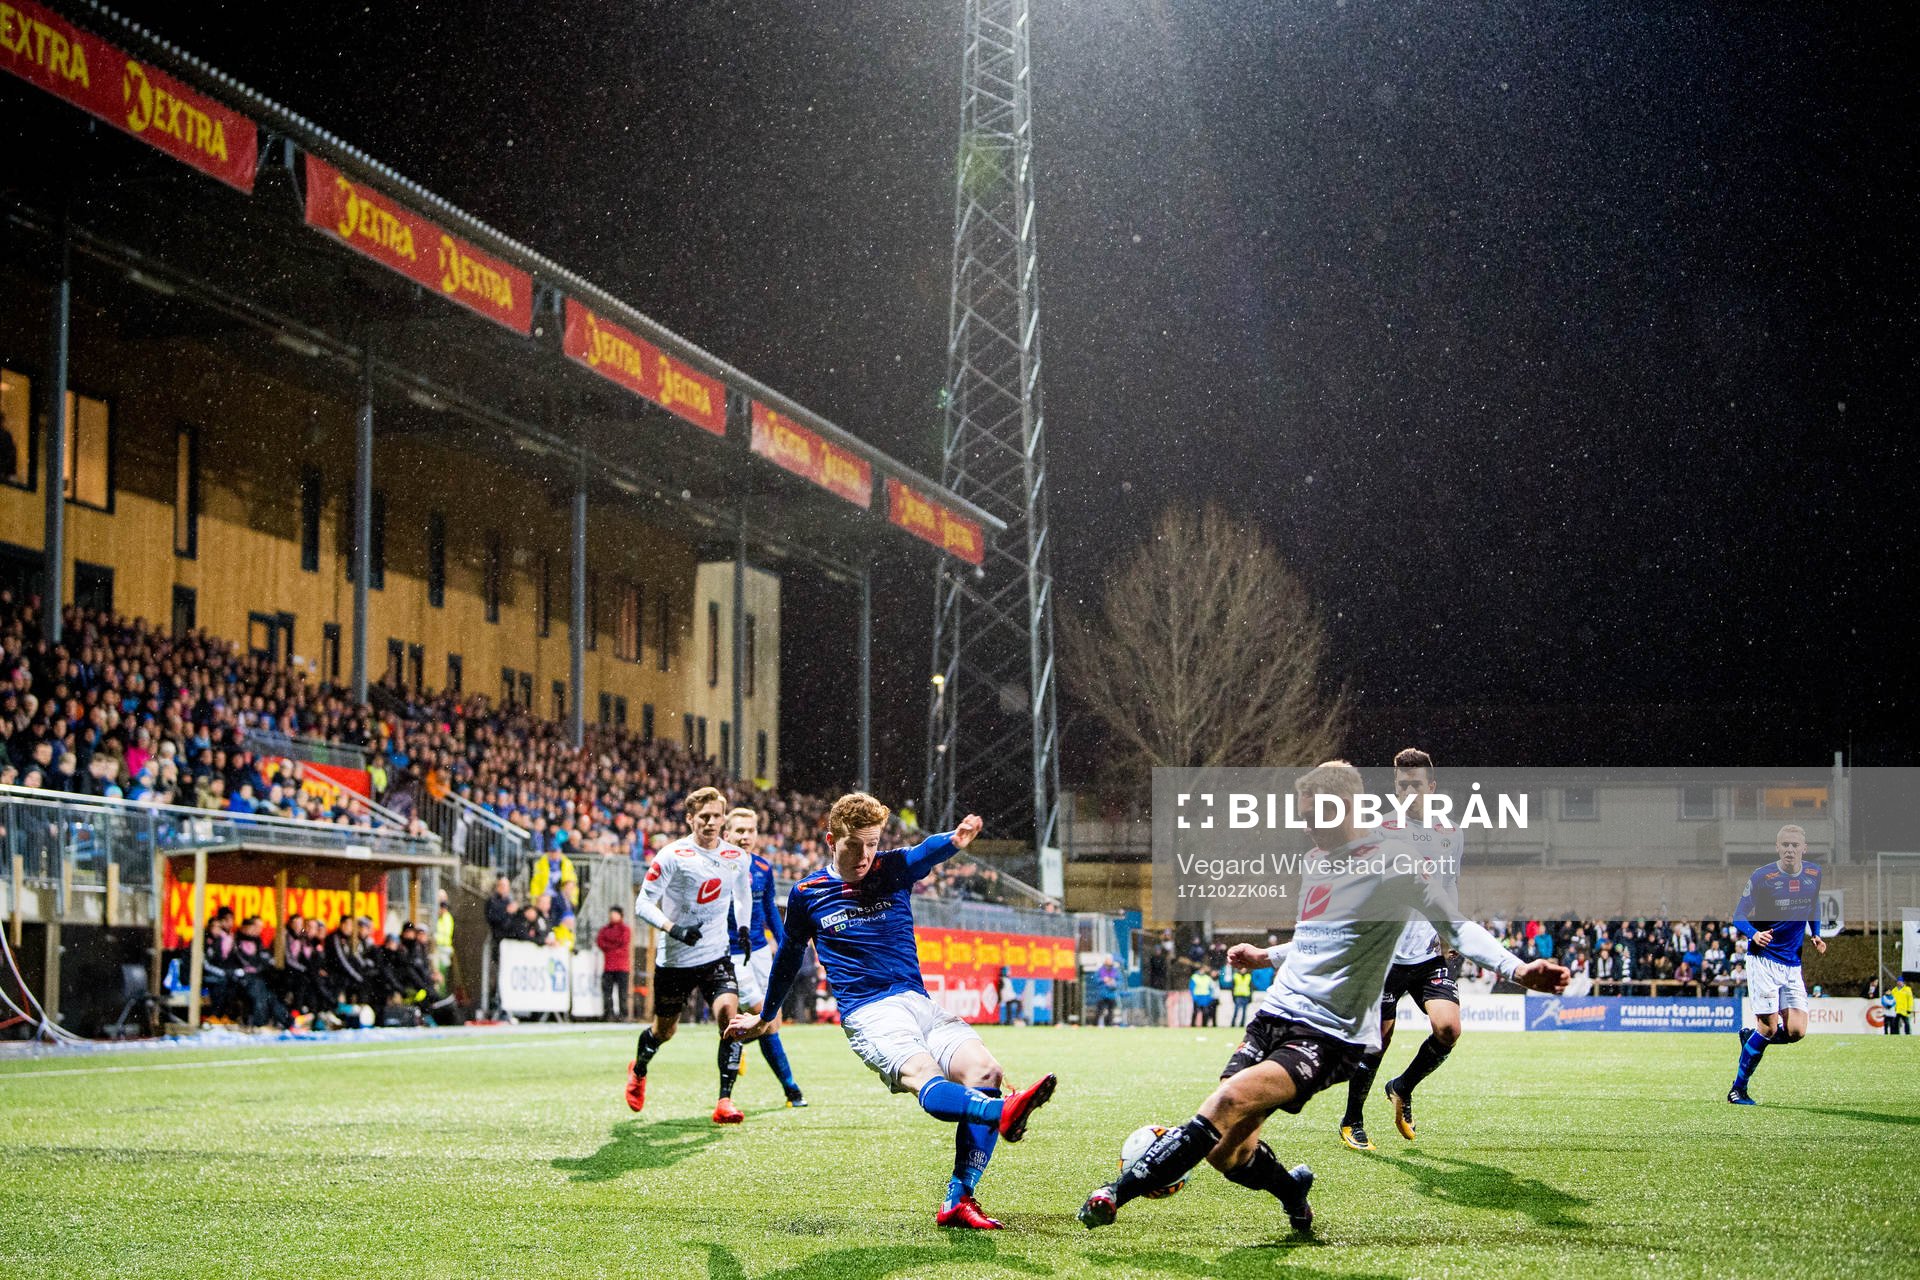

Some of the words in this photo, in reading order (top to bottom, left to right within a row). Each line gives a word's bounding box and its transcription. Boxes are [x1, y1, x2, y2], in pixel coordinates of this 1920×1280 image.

[0, 3, 89, 89] EXTRA
[153, 87, 228, 161] EXTRA
[359, 199, 416, 262] EXTRA
[461, 254, 513, 311] EXTRA
[1620, 1004, 1734, 1018] runnerteam.no
